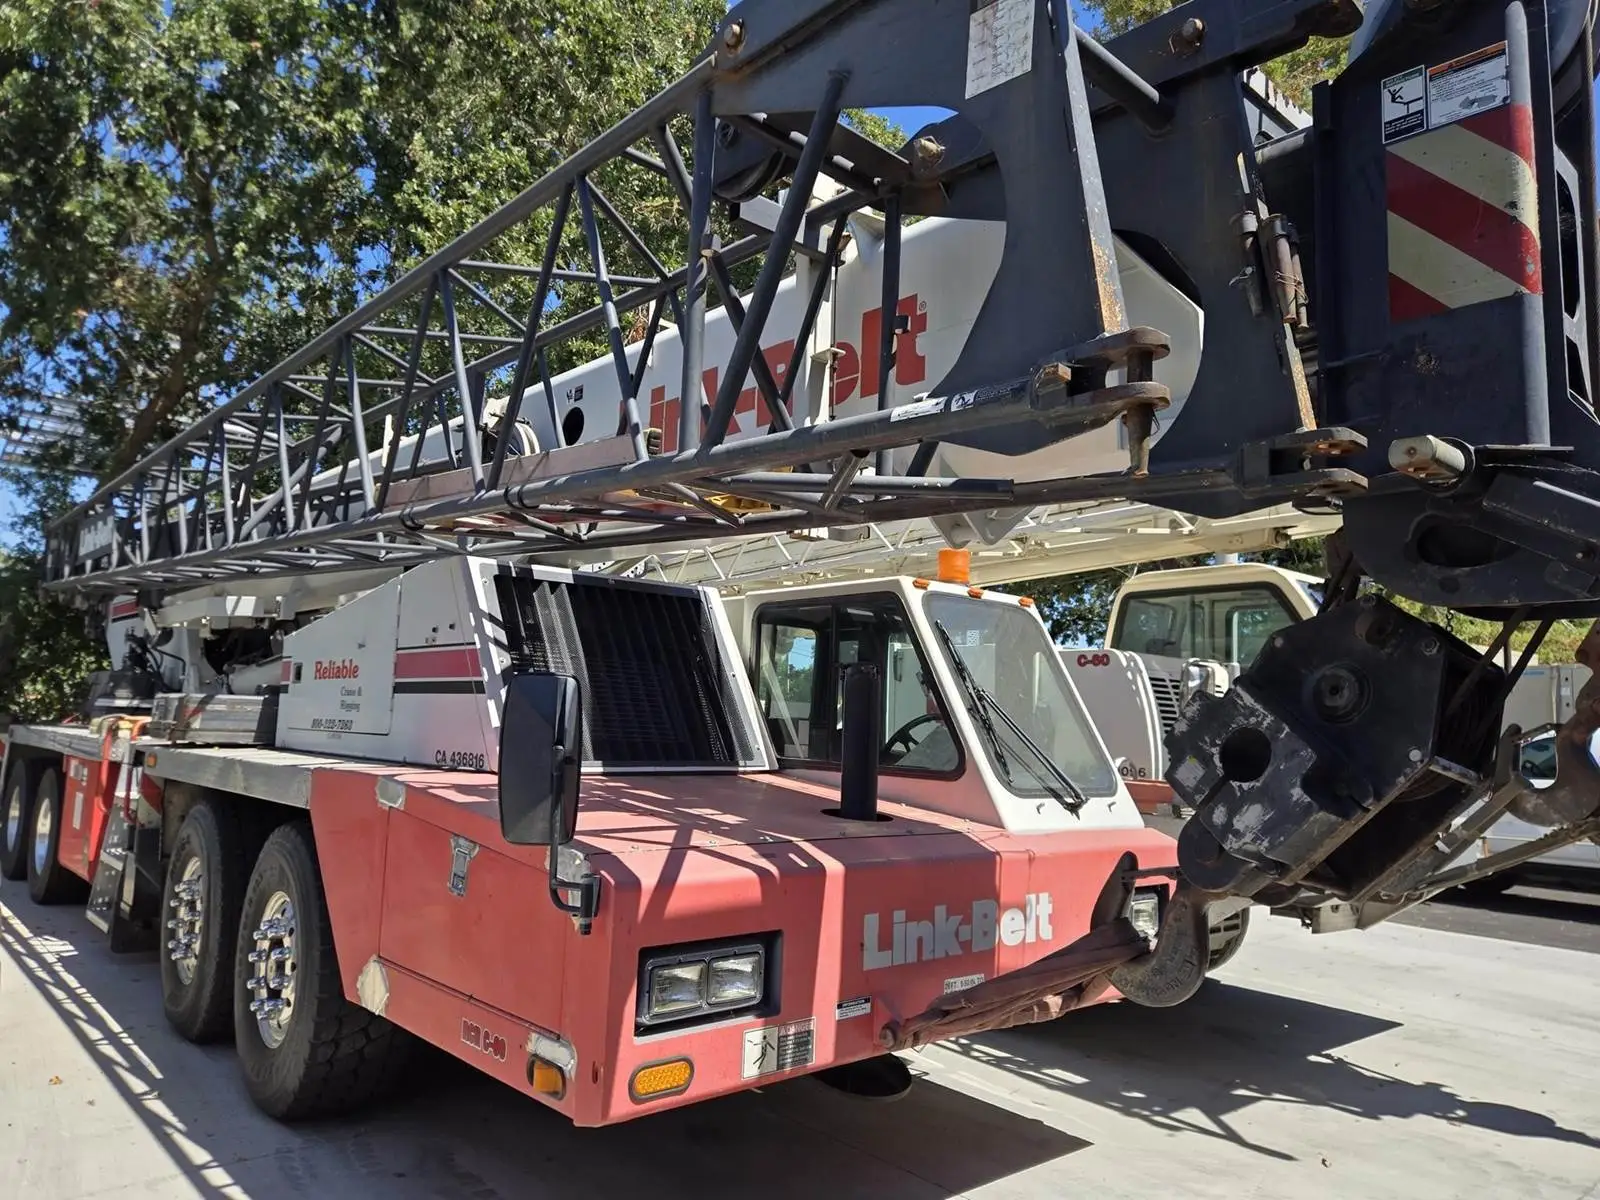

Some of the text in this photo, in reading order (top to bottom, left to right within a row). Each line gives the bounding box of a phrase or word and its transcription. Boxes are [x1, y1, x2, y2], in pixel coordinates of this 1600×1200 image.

[314, 658, 359, 681] Reliable
[435, 750, 447, 765] CA
[863, 892, 1053, 971] Link-Belt
